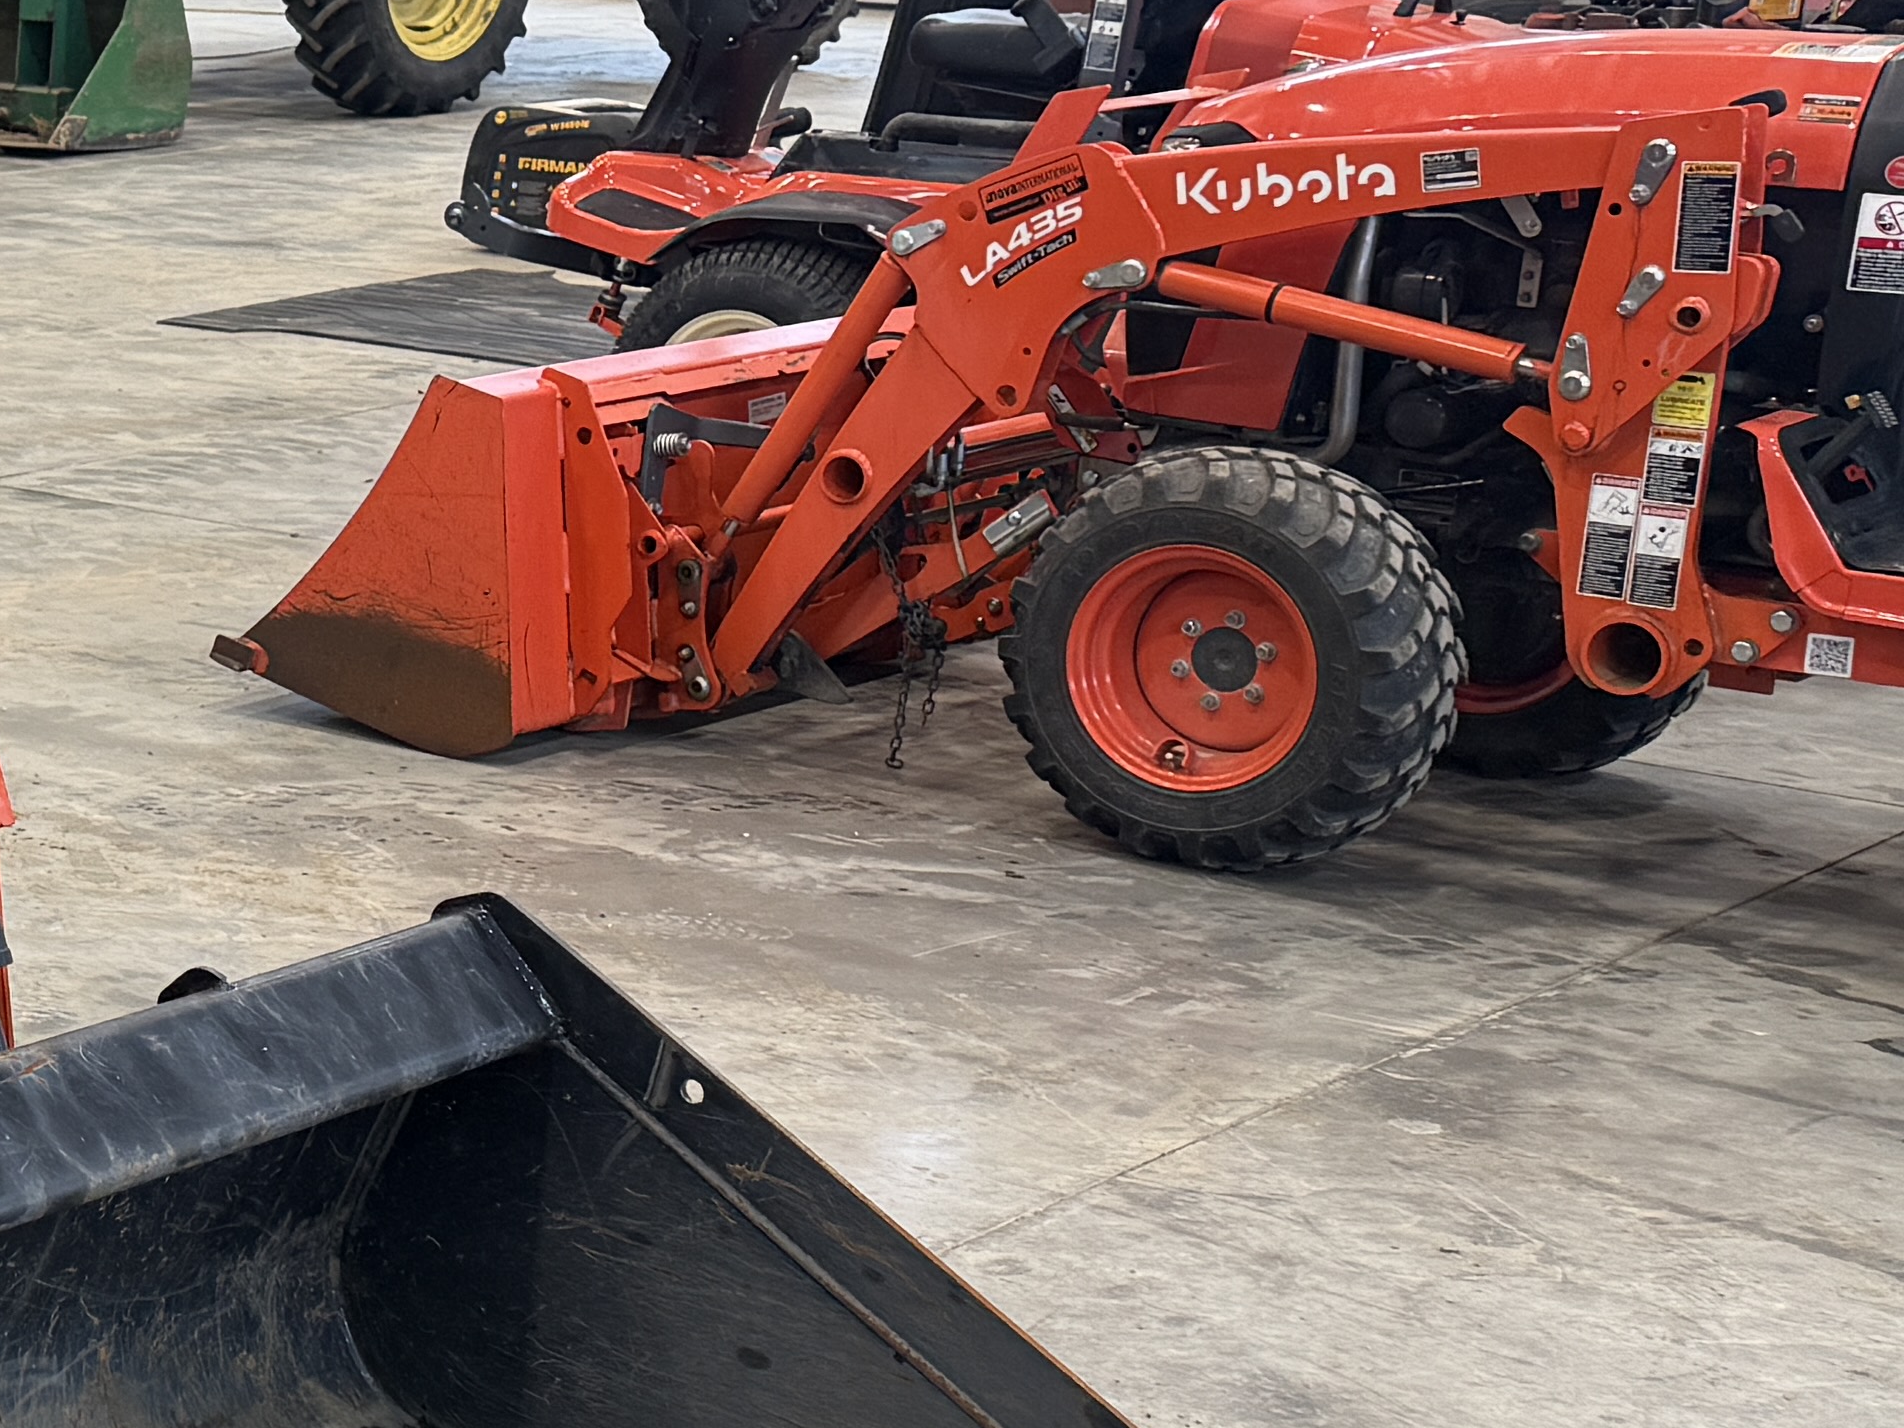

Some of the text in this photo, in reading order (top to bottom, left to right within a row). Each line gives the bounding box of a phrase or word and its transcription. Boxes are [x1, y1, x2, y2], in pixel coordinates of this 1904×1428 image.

[518, 157, 589, 174] FIRMAN
[1175, 152, 1396, 215] Kubota
[960, 196, 1083, 287] LA435
[996, 232, 1074, 284] Swift-Tach
